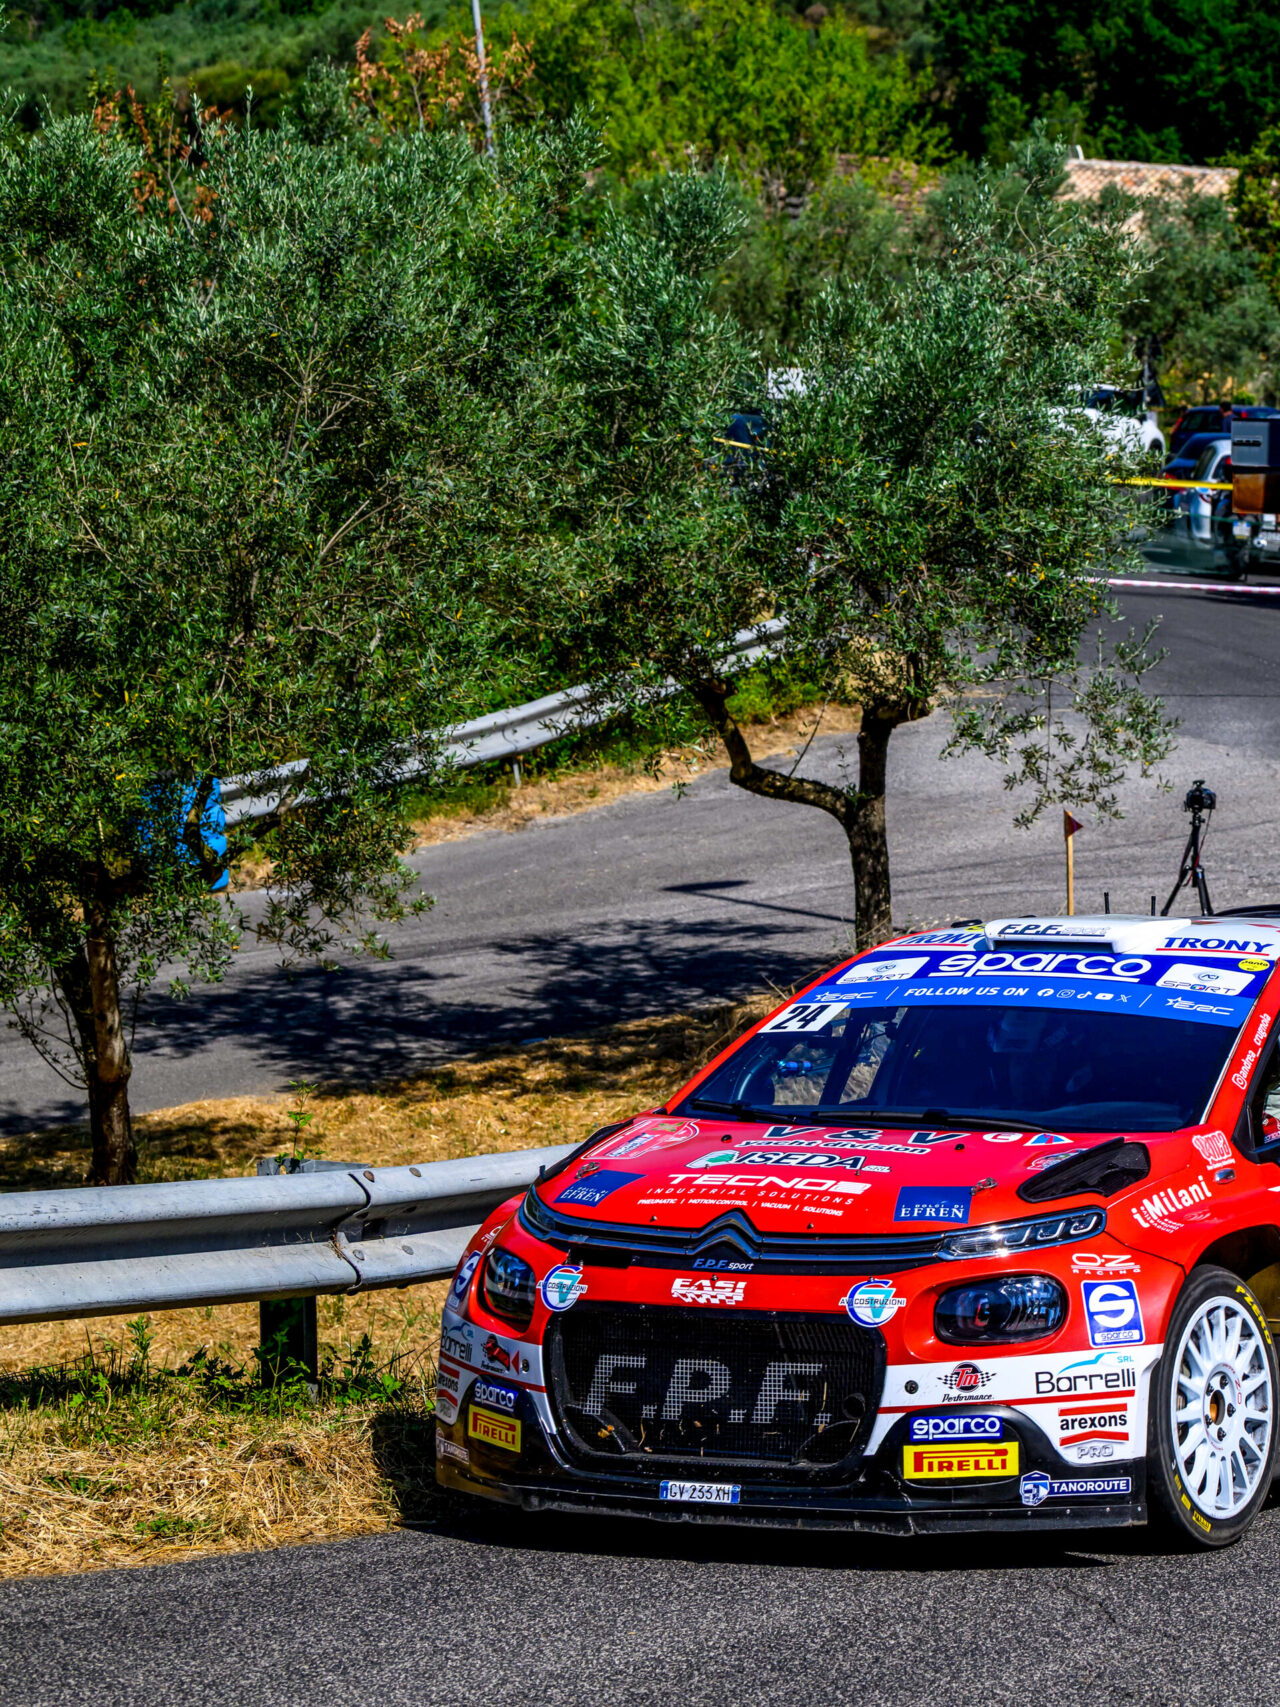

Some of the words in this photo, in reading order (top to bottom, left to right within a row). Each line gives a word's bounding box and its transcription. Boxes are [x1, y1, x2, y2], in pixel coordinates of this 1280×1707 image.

[1164, 937, 1274, 953] TRONY
[936, 952, 1152, 978] sparco
[904, 987, 975, 997] FOLLOW
[975, 987, 1001, 996] US
[1002, 988, 1029, 997] ON
[1161, 980, 1237, 995] SPORT
[769, 1004, 832, 1031] 24
[763, 1126, 826, 1139] V
[824, 1128, 883, 1141] &
[907, 1130, 971, 1146] V
[734, 1139, 824, 1149] yacht
[820, 1141, 931, 1155] division
[560, 1188, 603, 1203] EFREN
[647, 1187, 747, 1197] INDUSTRIAL
[757, 1190, 854, 1205] SOLUTIONS
[637, 1198, 678, 1206] PNEUMATIC
[688, 1198, 716, 1206] MOTION
[760, 1202, 791, 1210] VACUUM
[802, 1205, 844, 1217] SOLUTIONS
[900, 1207, 965, 1219] EFREN
[728, 1262, 754, 1271] sport
[854, 1297, 906, 1306] COSTRUZIONI
[1235, 1284, 1273, 1346] PZERO
[1100, 1330, 1134, 1341] sparco
[441, 1327, 473, 1363] Borrelli
[1116, 1355, 1135, 1363] SRL
[1035, 1367, 1136, 1395] Borrelli
[474, 1381, 515, 1408] sparco
[942, 1393, 994, 1403] Performance
[472, 1411, 517, 1446] PIRELLI
[912, 1416, 1001, 1440] sparco
[1059, 1413, 1128, 1431] arexons
[1077, 1445, 1115, 1459] PRO
[913, 1448, 1009, 1473] PIRELLI
[669, 1483, 686, 1499] GV
[1051, 1480, 1128, 1493] TANOROUTE
